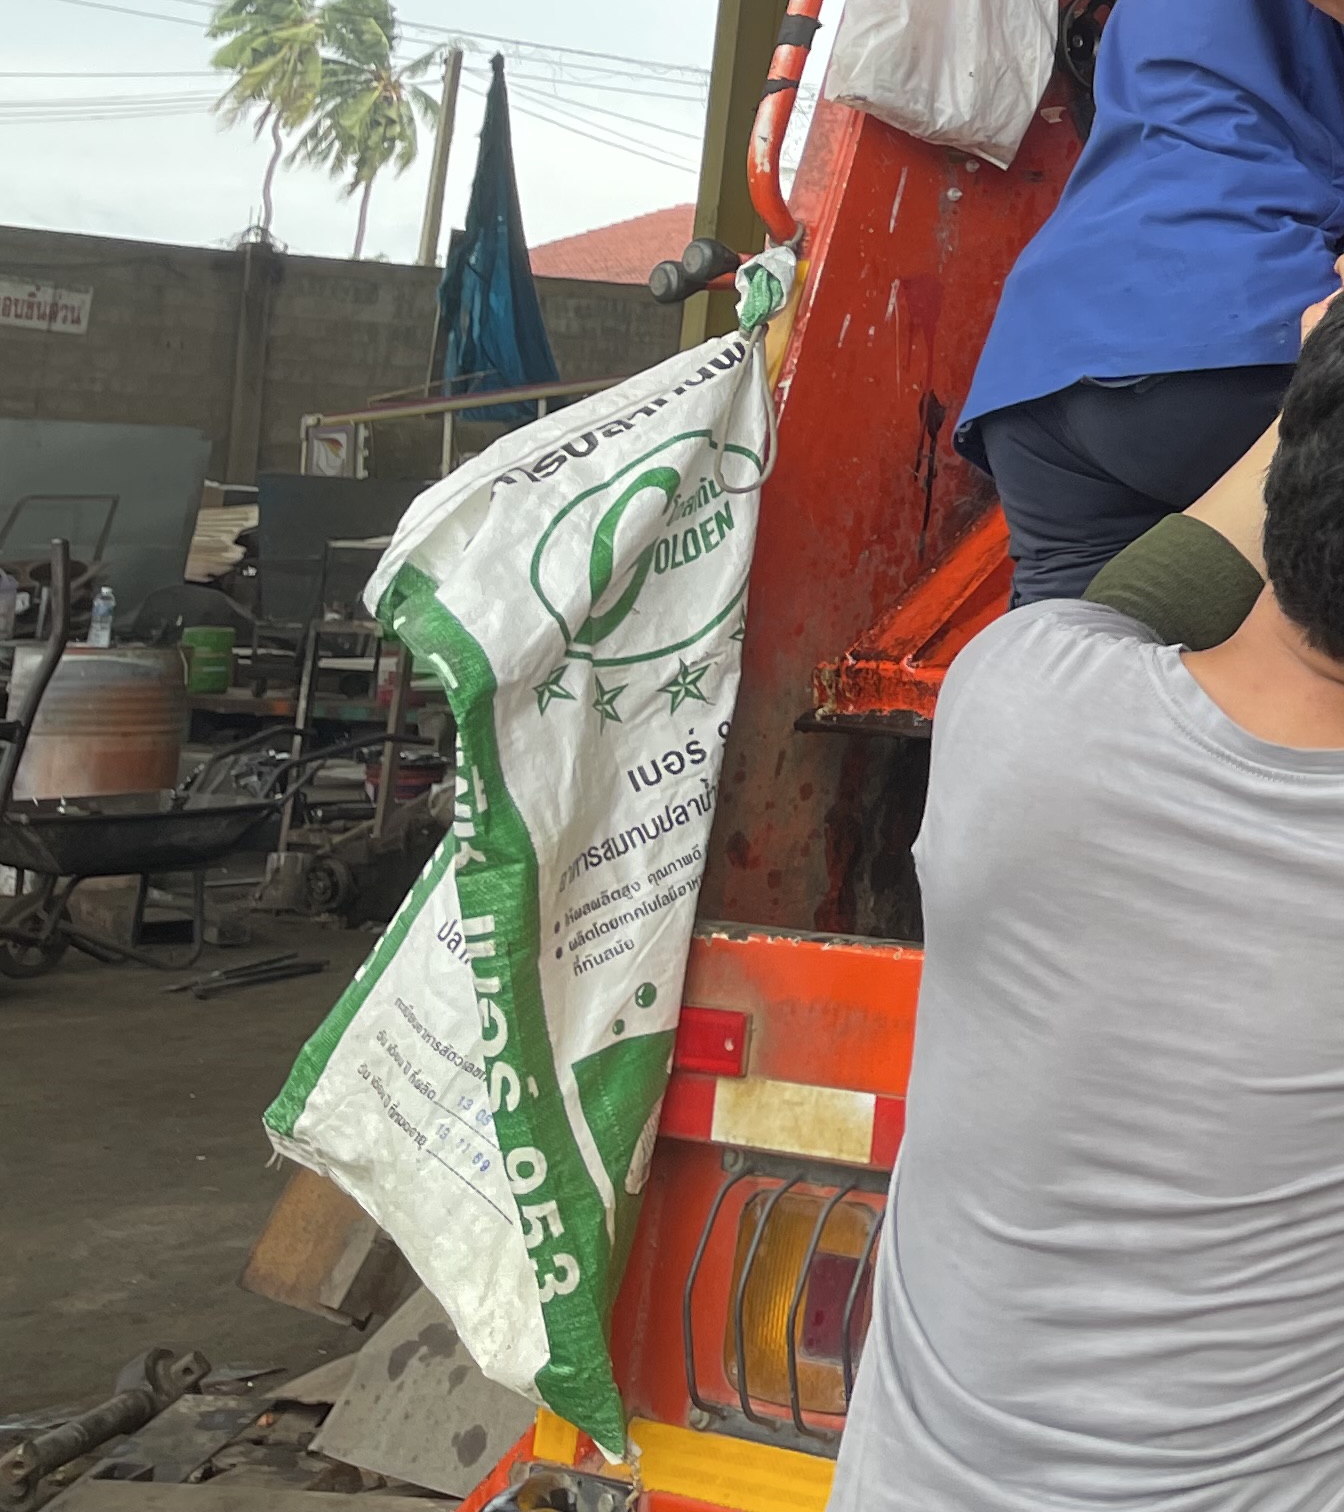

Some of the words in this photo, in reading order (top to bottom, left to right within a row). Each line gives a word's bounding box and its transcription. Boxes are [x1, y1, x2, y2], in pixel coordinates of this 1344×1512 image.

[627, 727, 707, 792] เบอร์
[647, 844, 702, 886] คุณภาพดี
[457, 1095, 474, 1111] 13
